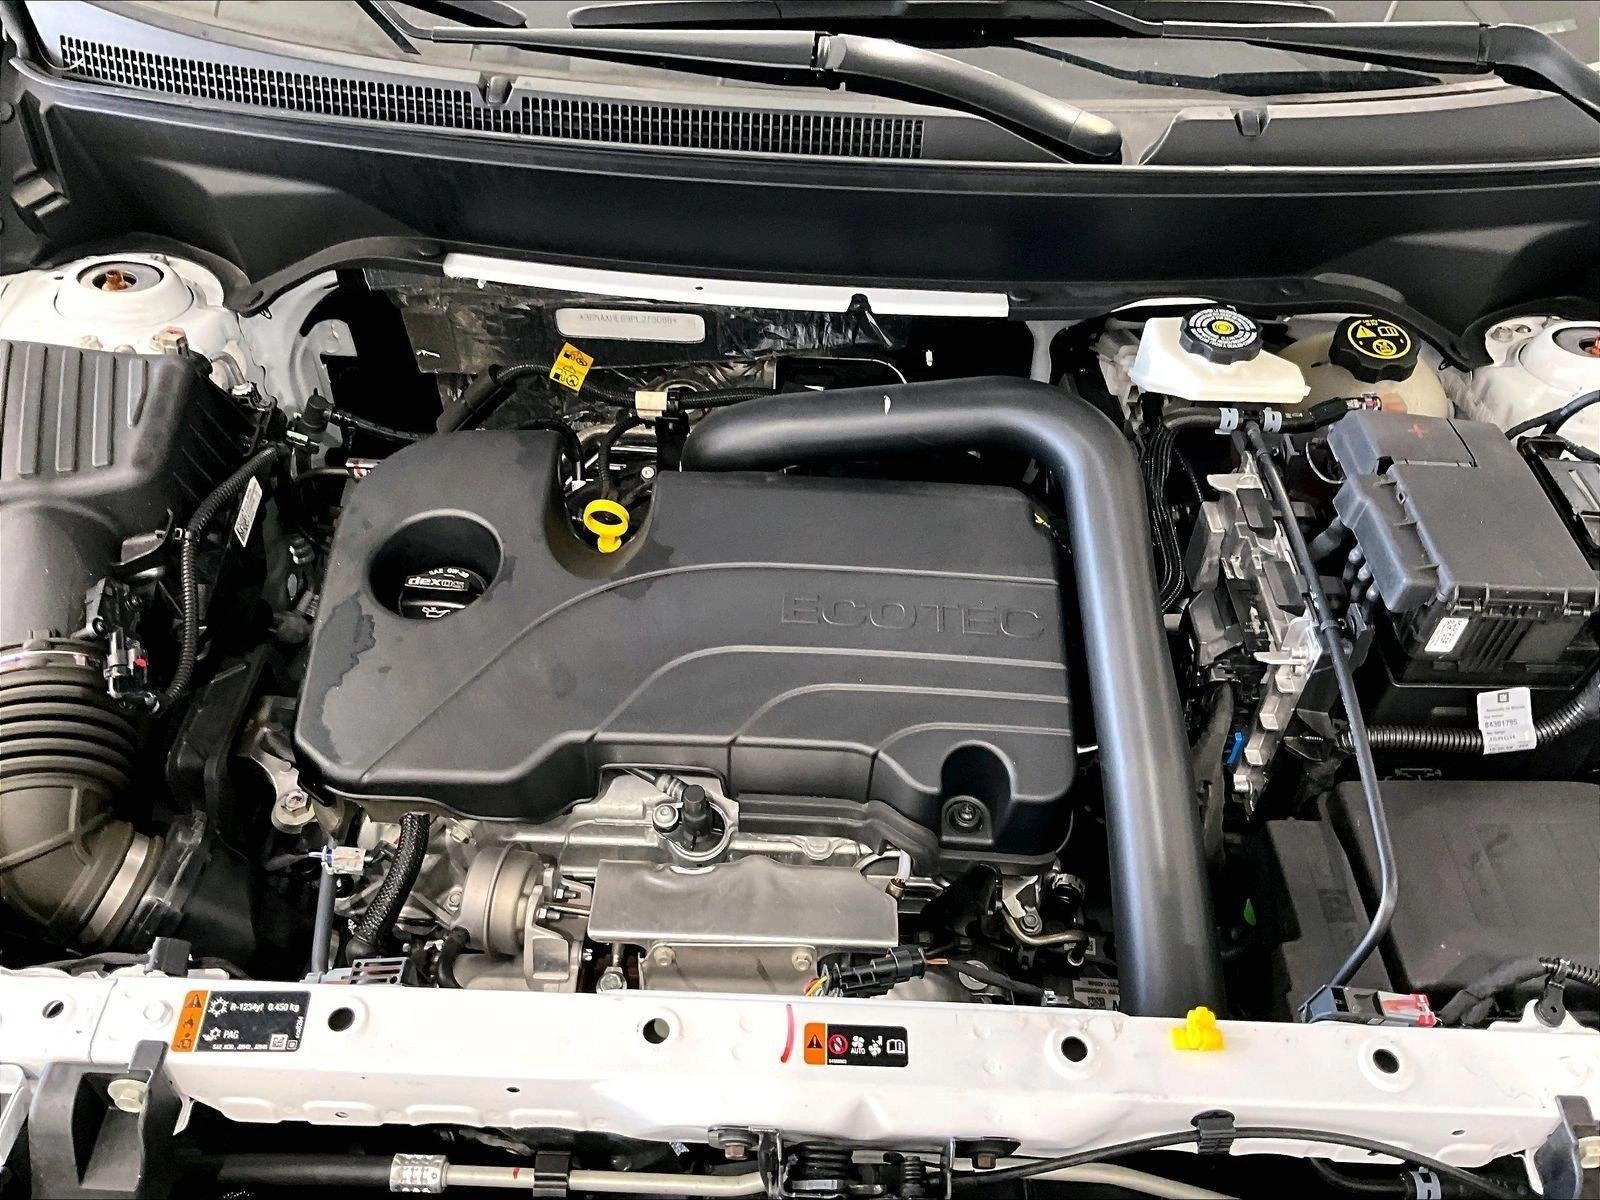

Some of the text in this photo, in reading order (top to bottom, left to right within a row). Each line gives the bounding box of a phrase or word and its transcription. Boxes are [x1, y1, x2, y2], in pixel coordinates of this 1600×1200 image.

[407, 576, 465, 589] dexos
[781, 593, 1045, 638] ECOTEC
[229, 1002, 300, 1013] R-1234yf 0.450 kg
[222, 1030, 240, 1039] PAG
[850, 1047, 866, 1055] AUTO
